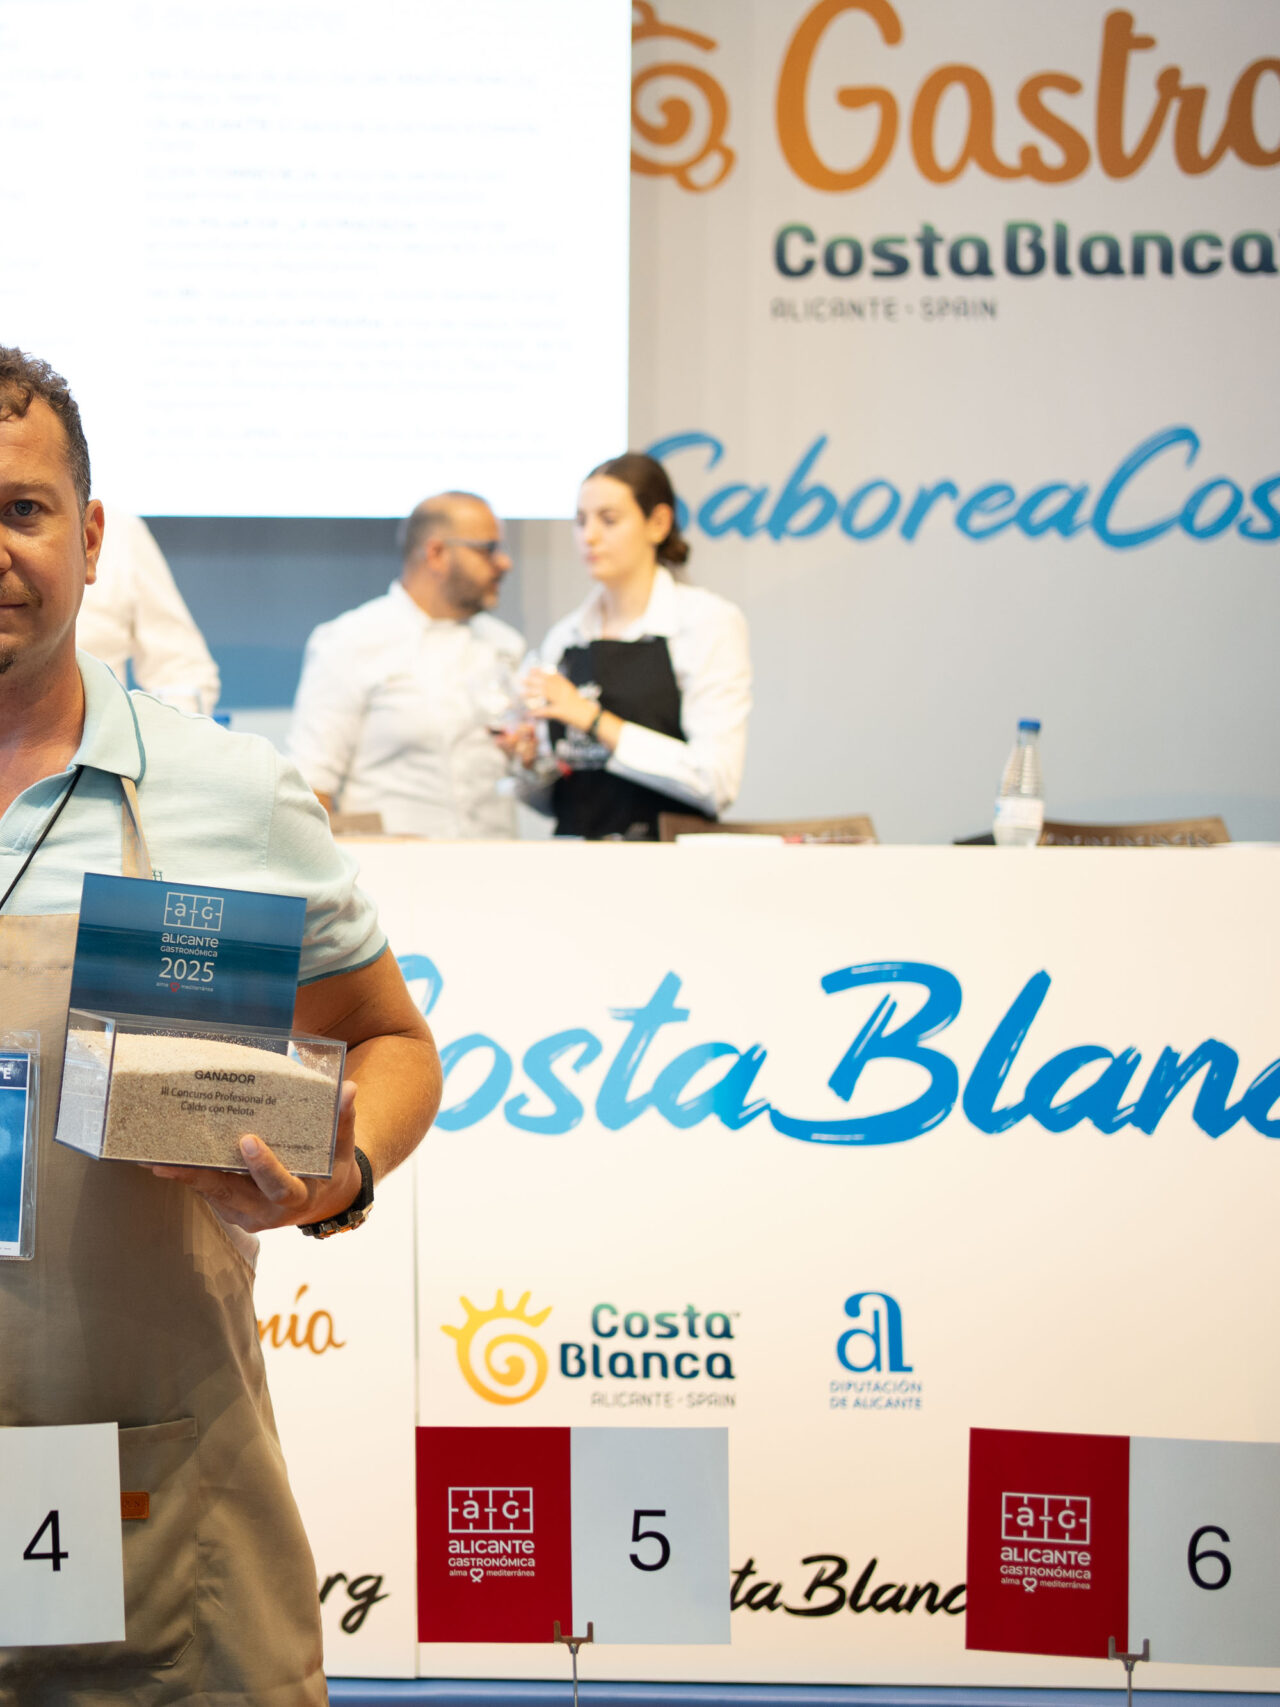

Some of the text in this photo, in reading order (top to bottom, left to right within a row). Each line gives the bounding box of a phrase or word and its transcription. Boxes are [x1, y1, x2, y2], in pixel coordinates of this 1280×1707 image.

[158, 957, 215, 983] 2025
[195, 1070, 256, 1085] GANADOR
[171, 1087, 213, 1100] Concurso
[215, 1091, 264, 1105] Profesional
[265, 1096, 277, 1105] de
[180, 1101, 254, 1117] Caldo con Pelota
[591, 1302, 735, 1339] Costa
[559, 1341, 736, 1380] Blanca
[829, 1379, 923, 1394] DIPUTACIÓN
[591, 1391, 736, 1409] ALICANTE SPAIN
[830, 1396, 923, 1411] DE ALICANTE
[23, 1509, 69, 1572] 4
[629, 1509, 671, 1572] 5
[1187, 1524, 1232, 1591] 6
